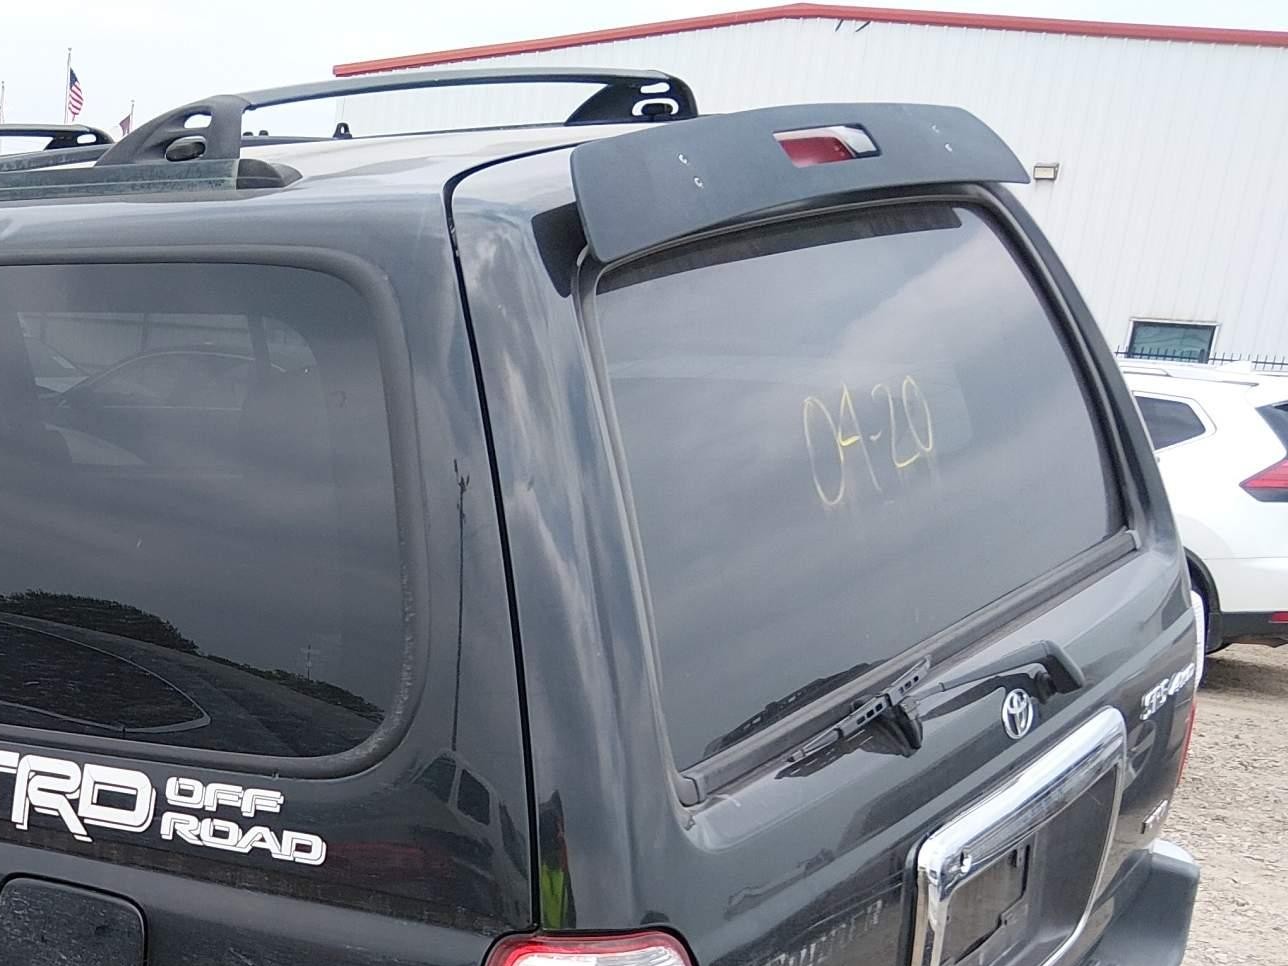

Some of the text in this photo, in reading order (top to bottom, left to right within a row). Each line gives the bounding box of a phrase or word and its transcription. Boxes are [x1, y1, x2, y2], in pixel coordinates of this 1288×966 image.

[803, 375, 933, 505] 04-20
[165, 776, 285, 818] OFF
[160, 811, 328, 866] ROAD
